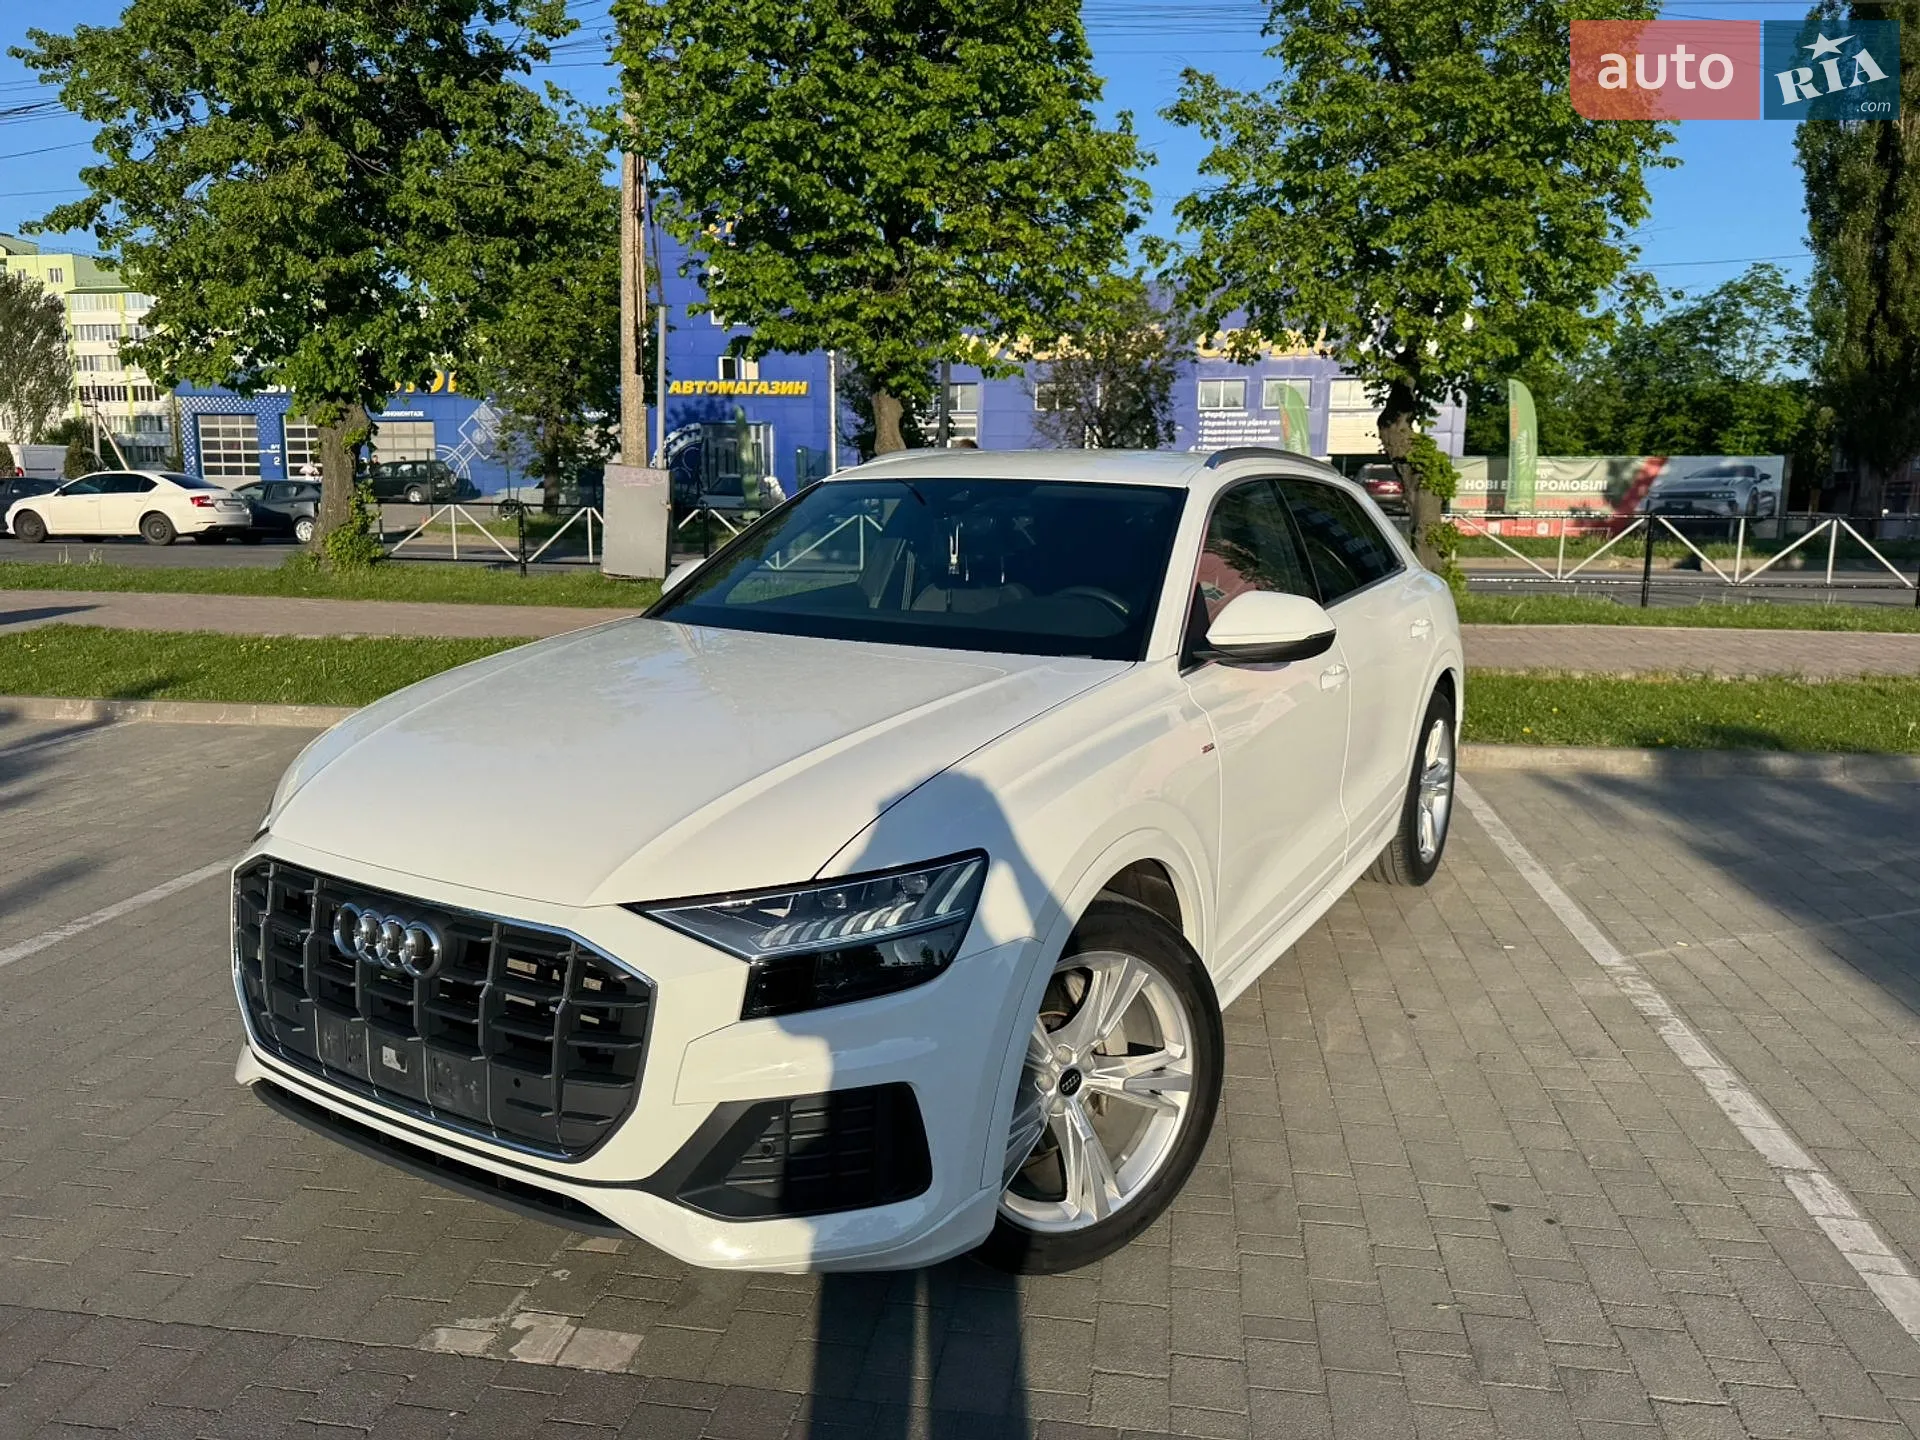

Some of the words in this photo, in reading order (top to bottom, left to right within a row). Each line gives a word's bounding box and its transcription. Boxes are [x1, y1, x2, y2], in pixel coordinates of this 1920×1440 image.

[668, 380, 808, 395] АВТОМАГАЗИН
[273, 457, 280, 466] 2
[1465, 479, 1499, 490] НОВІ
[1501, 479, 1608, 491] ЕТРОМОБІЛІ
